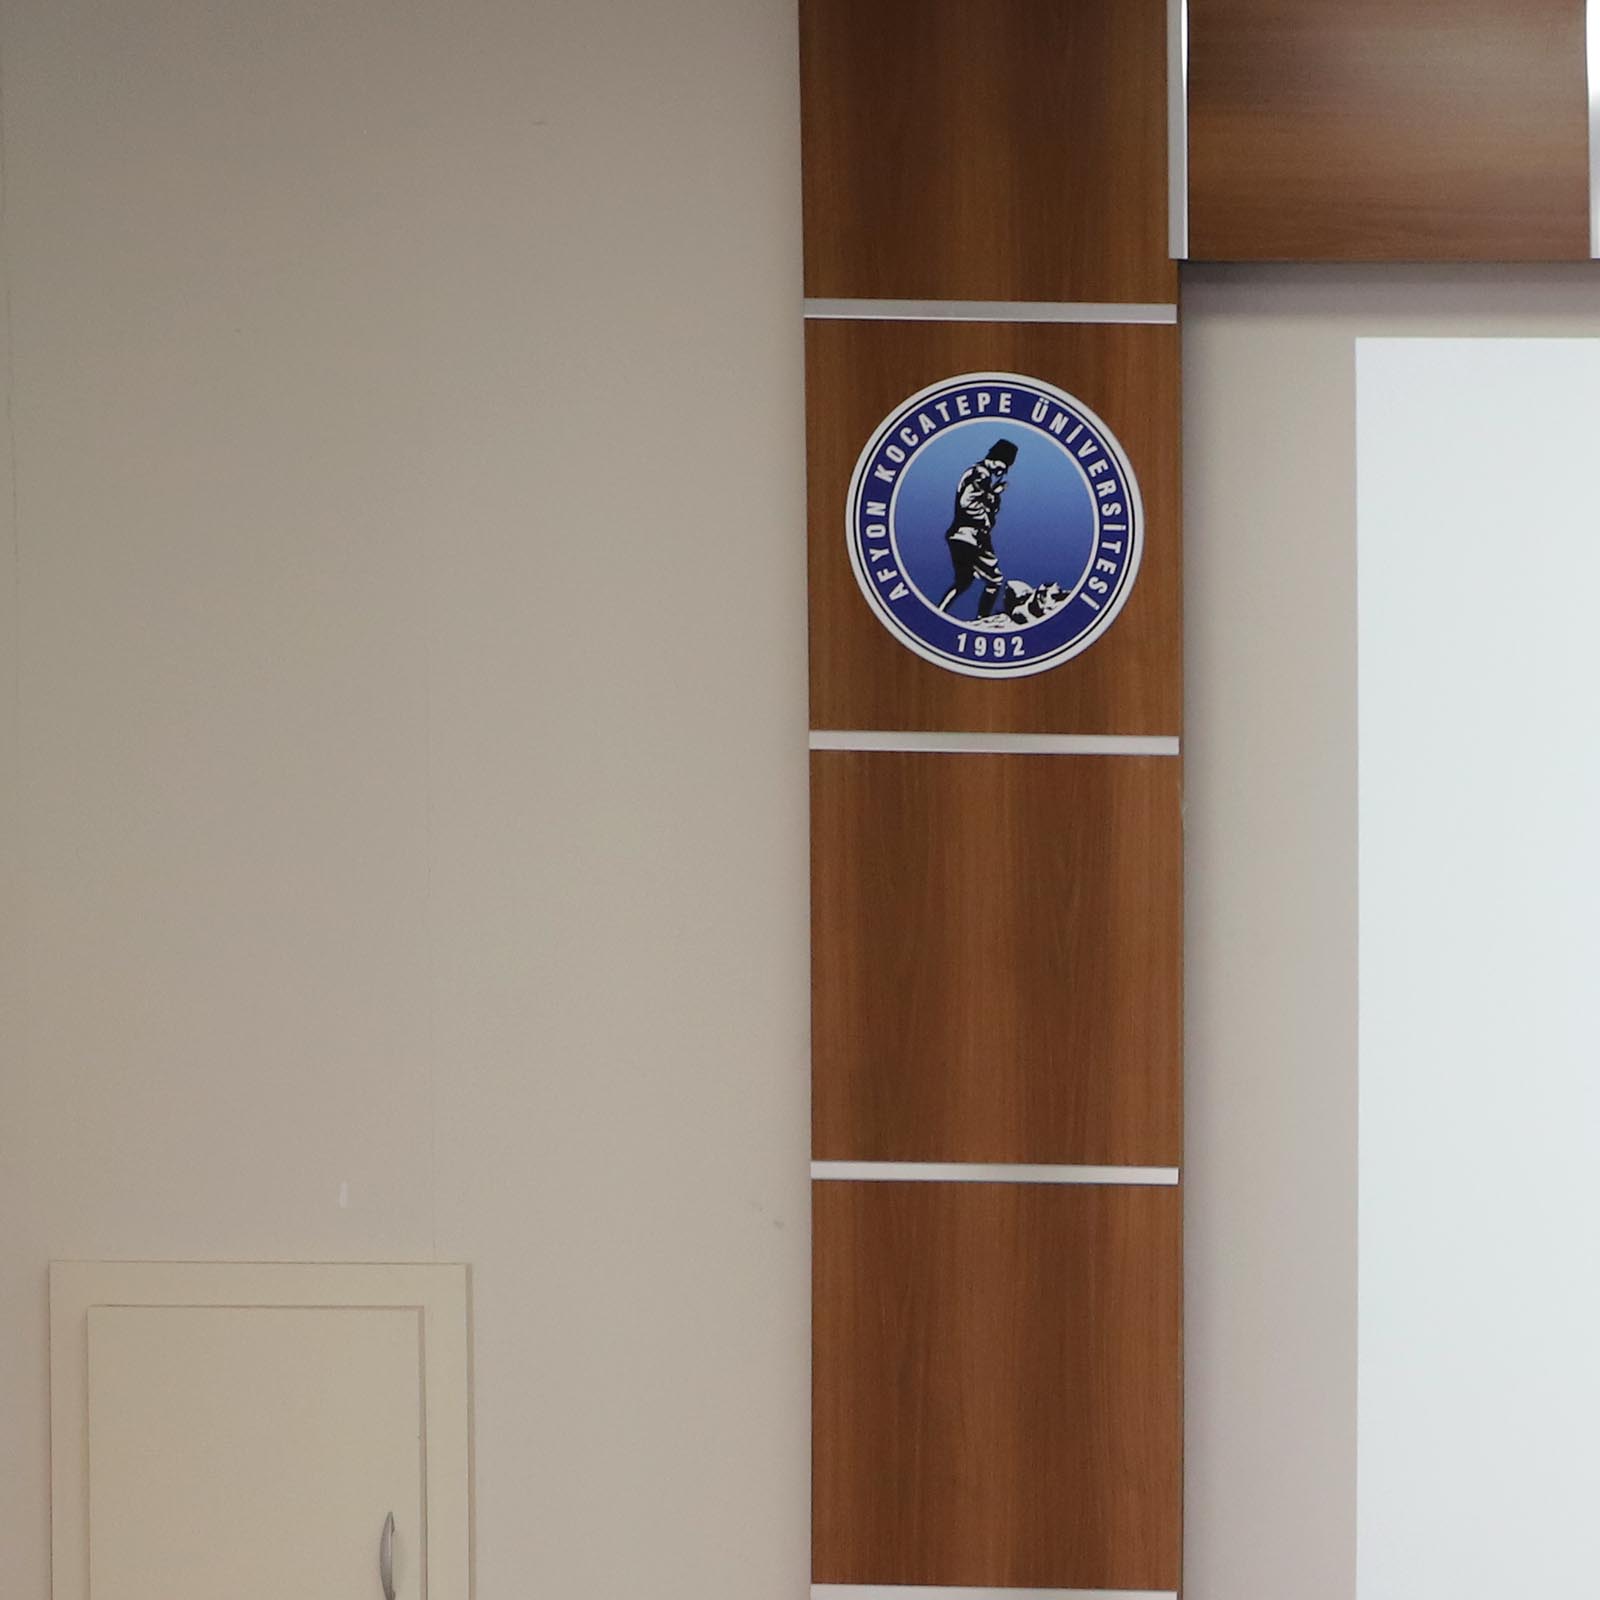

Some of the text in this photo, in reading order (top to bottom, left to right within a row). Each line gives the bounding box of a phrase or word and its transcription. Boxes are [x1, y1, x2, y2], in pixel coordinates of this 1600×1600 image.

[874, 392, 1012, 484] KOCATEPE
[865, 501, 910, 601] AFYON
[957, 632, 1025, 658] 1992
